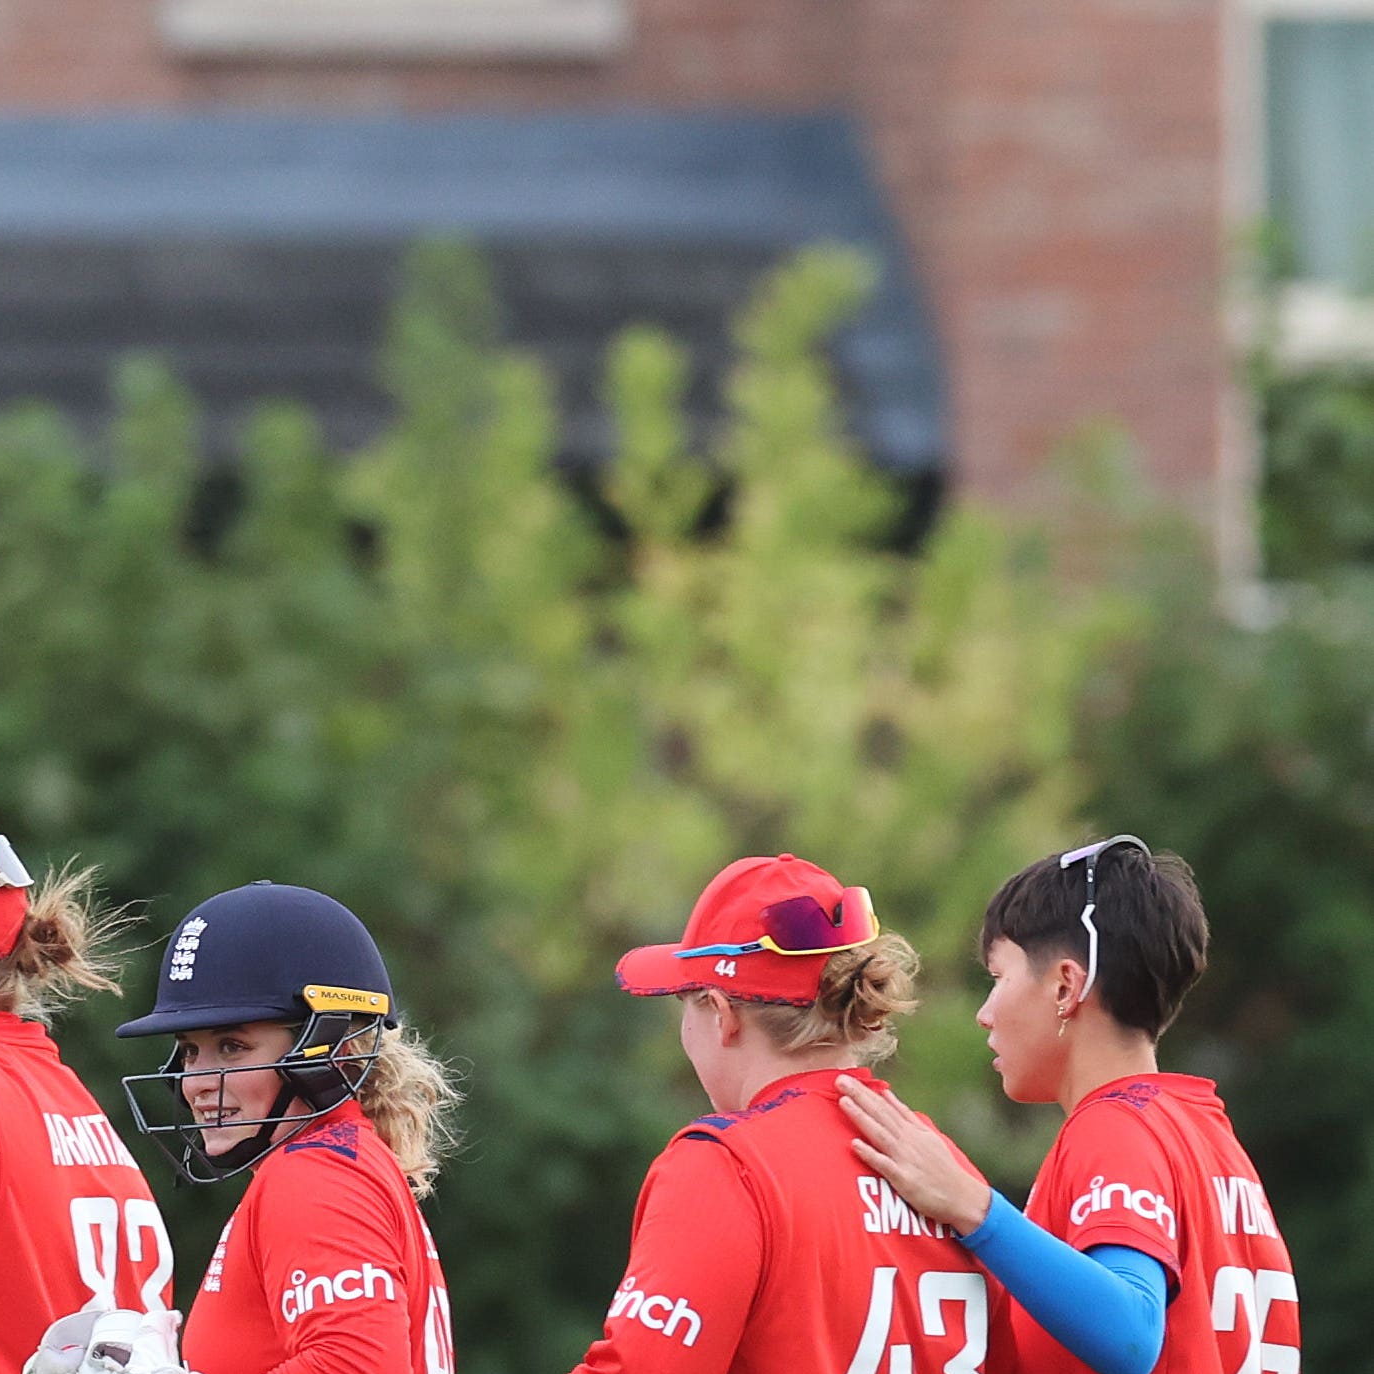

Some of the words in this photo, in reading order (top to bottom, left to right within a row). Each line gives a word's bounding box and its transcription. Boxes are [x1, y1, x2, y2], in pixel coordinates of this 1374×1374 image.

[714, 959, 737, 977] 44
[320, 991, 367, 1003] MASURI
[1070, 1175, 1177, 1241] cinch
[281, 1262, 396, 1324] cinch
